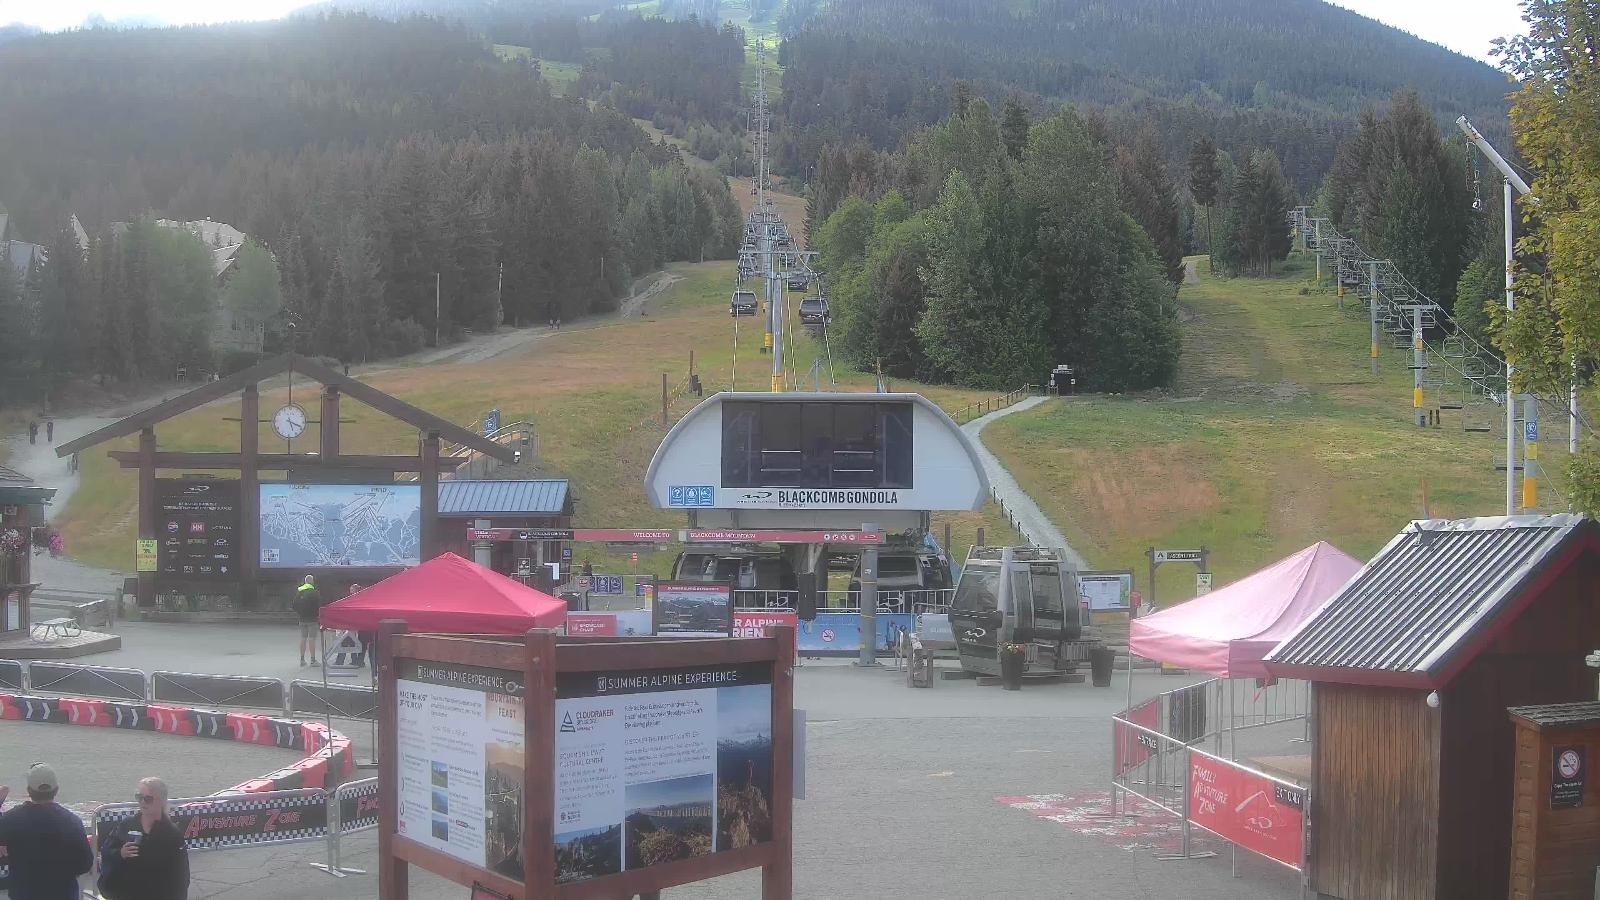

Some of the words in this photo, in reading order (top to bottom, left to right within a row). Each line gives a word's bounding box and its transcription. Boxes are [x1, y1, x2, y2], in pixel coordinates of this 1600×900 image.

[778, 490, 845, 504] BLACKCOMB
[846, 490, 898, 504] GONDOLA
[423, 667, 446, 680] SUMMER
[446, 670, 467, 684] ALPINE
[467, 672, 503, 688] EXPERIENCE
[608, 676, 648, 689] SUMMER
[650, 674, 683, 686] ALPINE
[685, 670, 737, 684] EXPERIENCE
[498, 706, 517, 719] FEAST
[575, 709, 614, 720] CLOUDRAKER
[1191, 764, 1217, 785] FAMILY
[1198, 797, 1217, 815] ZONE
[184, 813, 258, 839] ADVENTURE
[263, 808, 301, 833] ZONE
